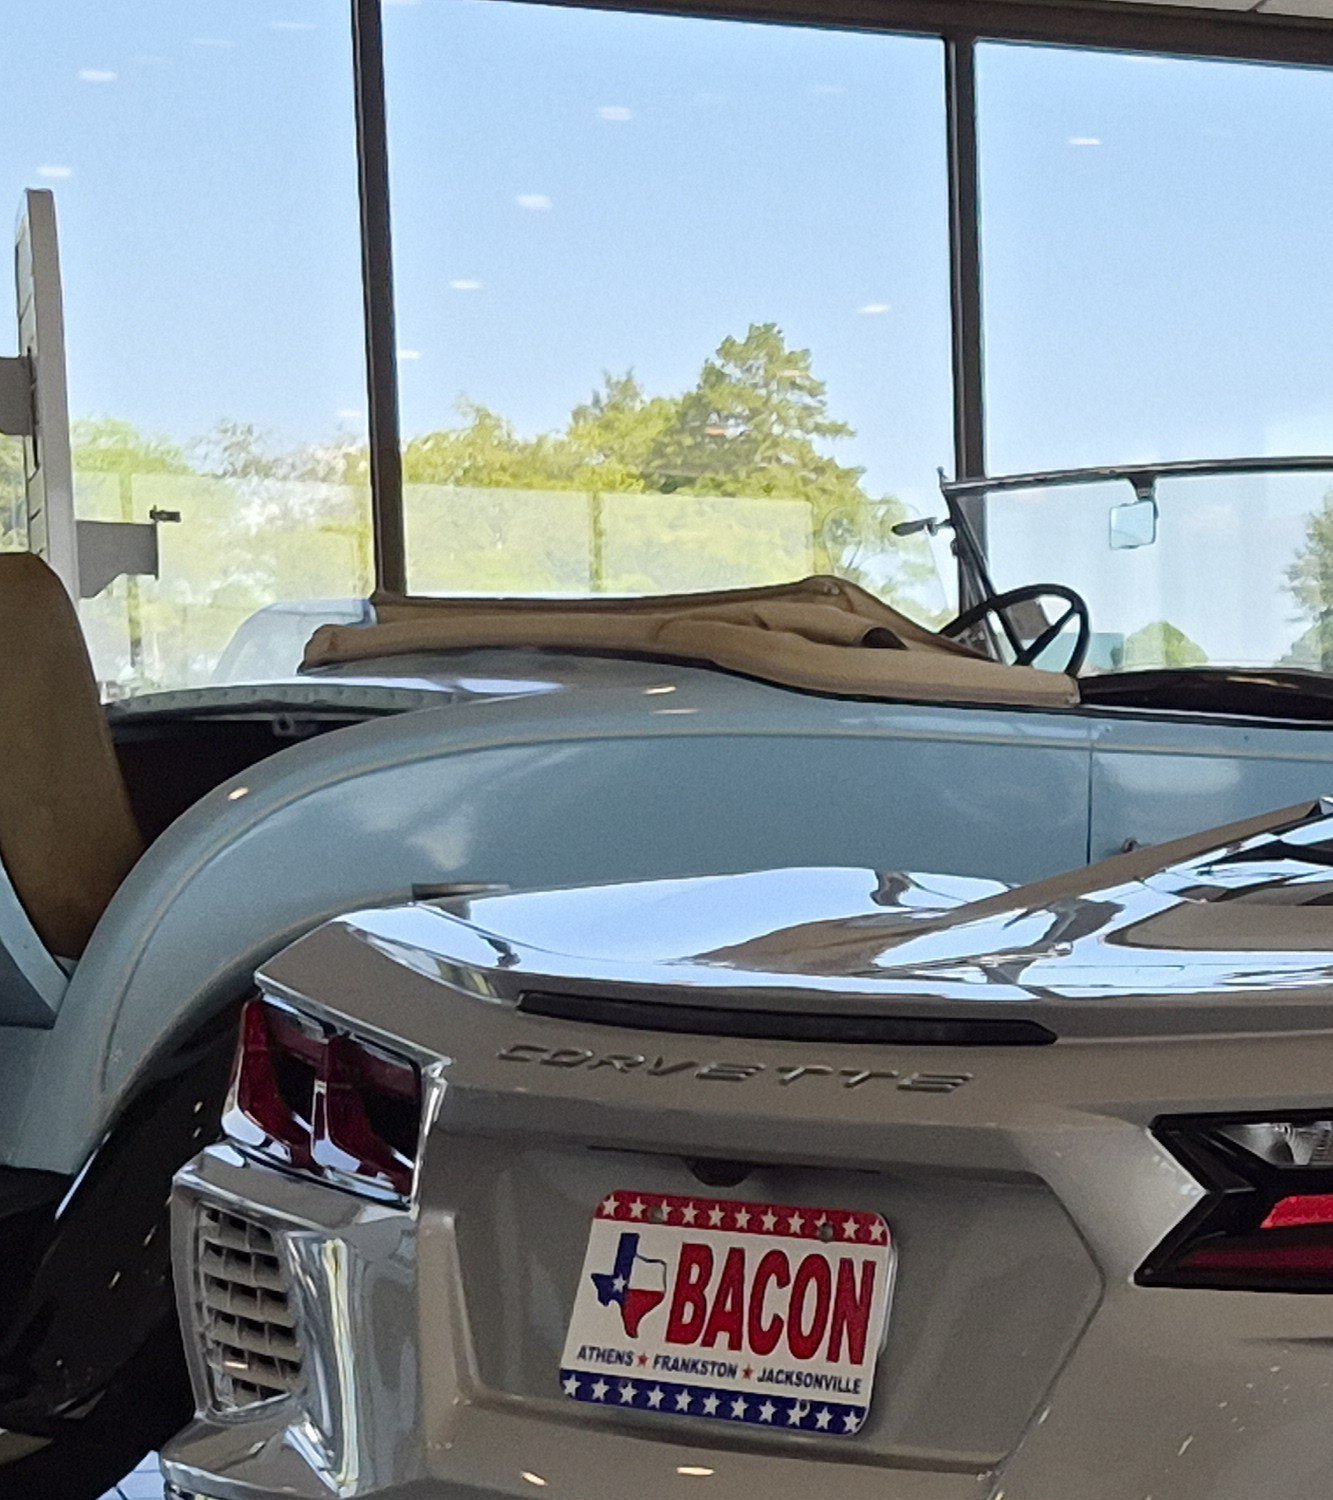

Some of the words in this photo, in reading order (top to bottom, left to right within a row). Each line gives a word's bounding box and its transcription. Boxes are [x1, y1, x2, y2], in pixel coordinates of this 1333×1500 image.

[497, 1044, 973, 1093] CORVETTE
[665, 1242, 876, 1365] BACON
[577, 1345, 633, 1366] ATHENS
[653, 1356, 737, 1379] FRANKSTON
[757, 1369, 862, 1394] JACKSONVILLE
